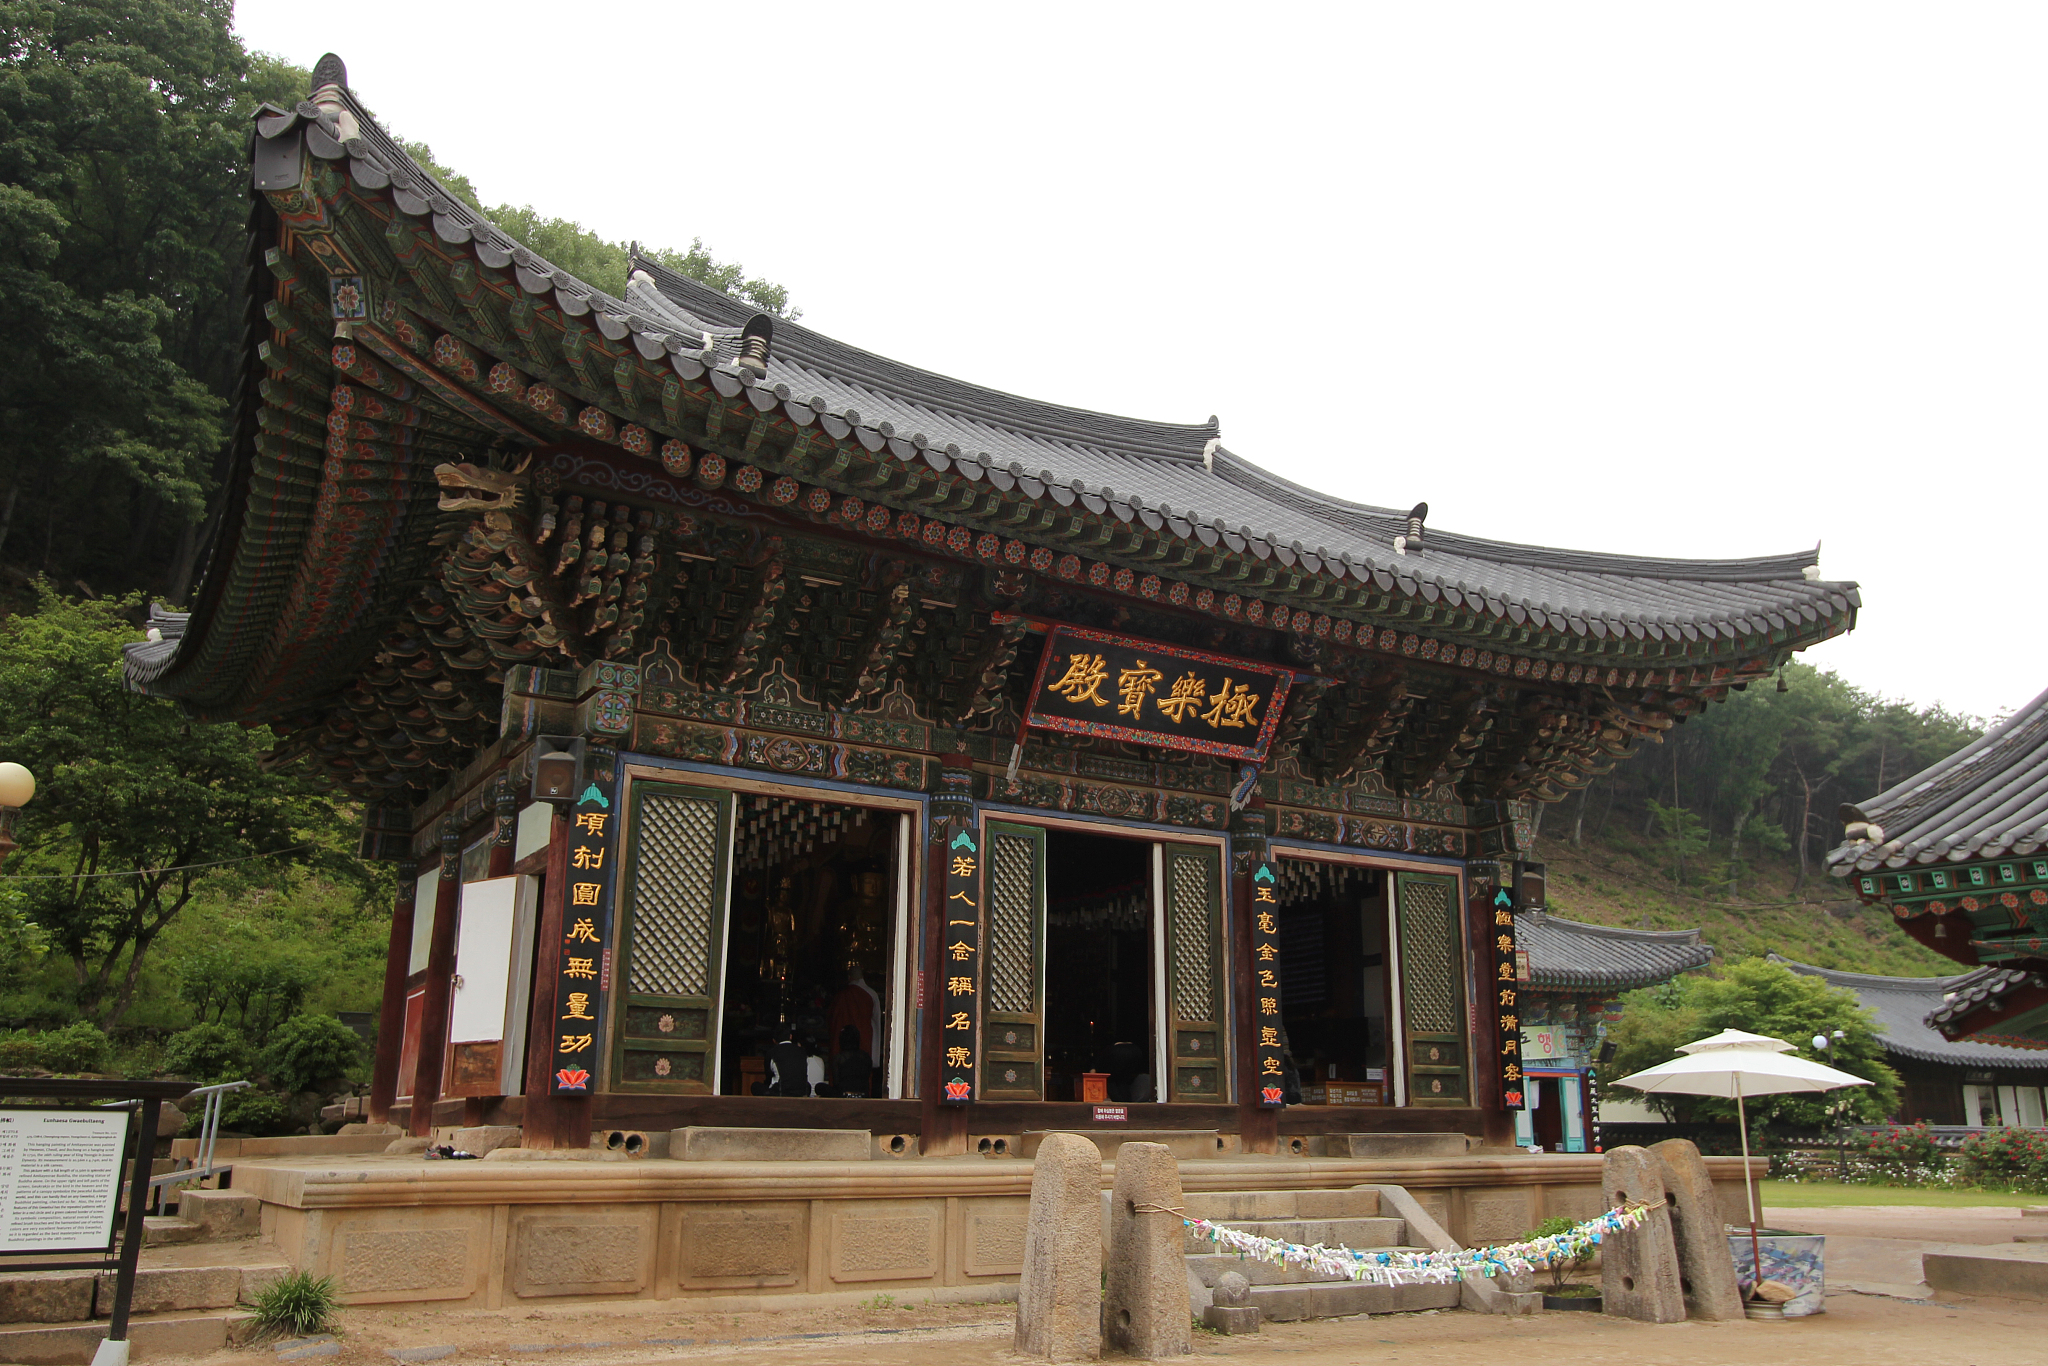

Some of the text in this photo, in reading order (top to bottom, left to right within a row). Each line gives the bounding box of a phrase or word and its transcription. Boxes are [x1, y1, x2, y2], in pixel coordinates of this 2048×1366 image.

[945, 855, 977, 1070] 若人一念稱名號
[1494, 908, 1523, 1082] 極樂堂前滿月容
[1536, 1032, 1552, 1054] 행
